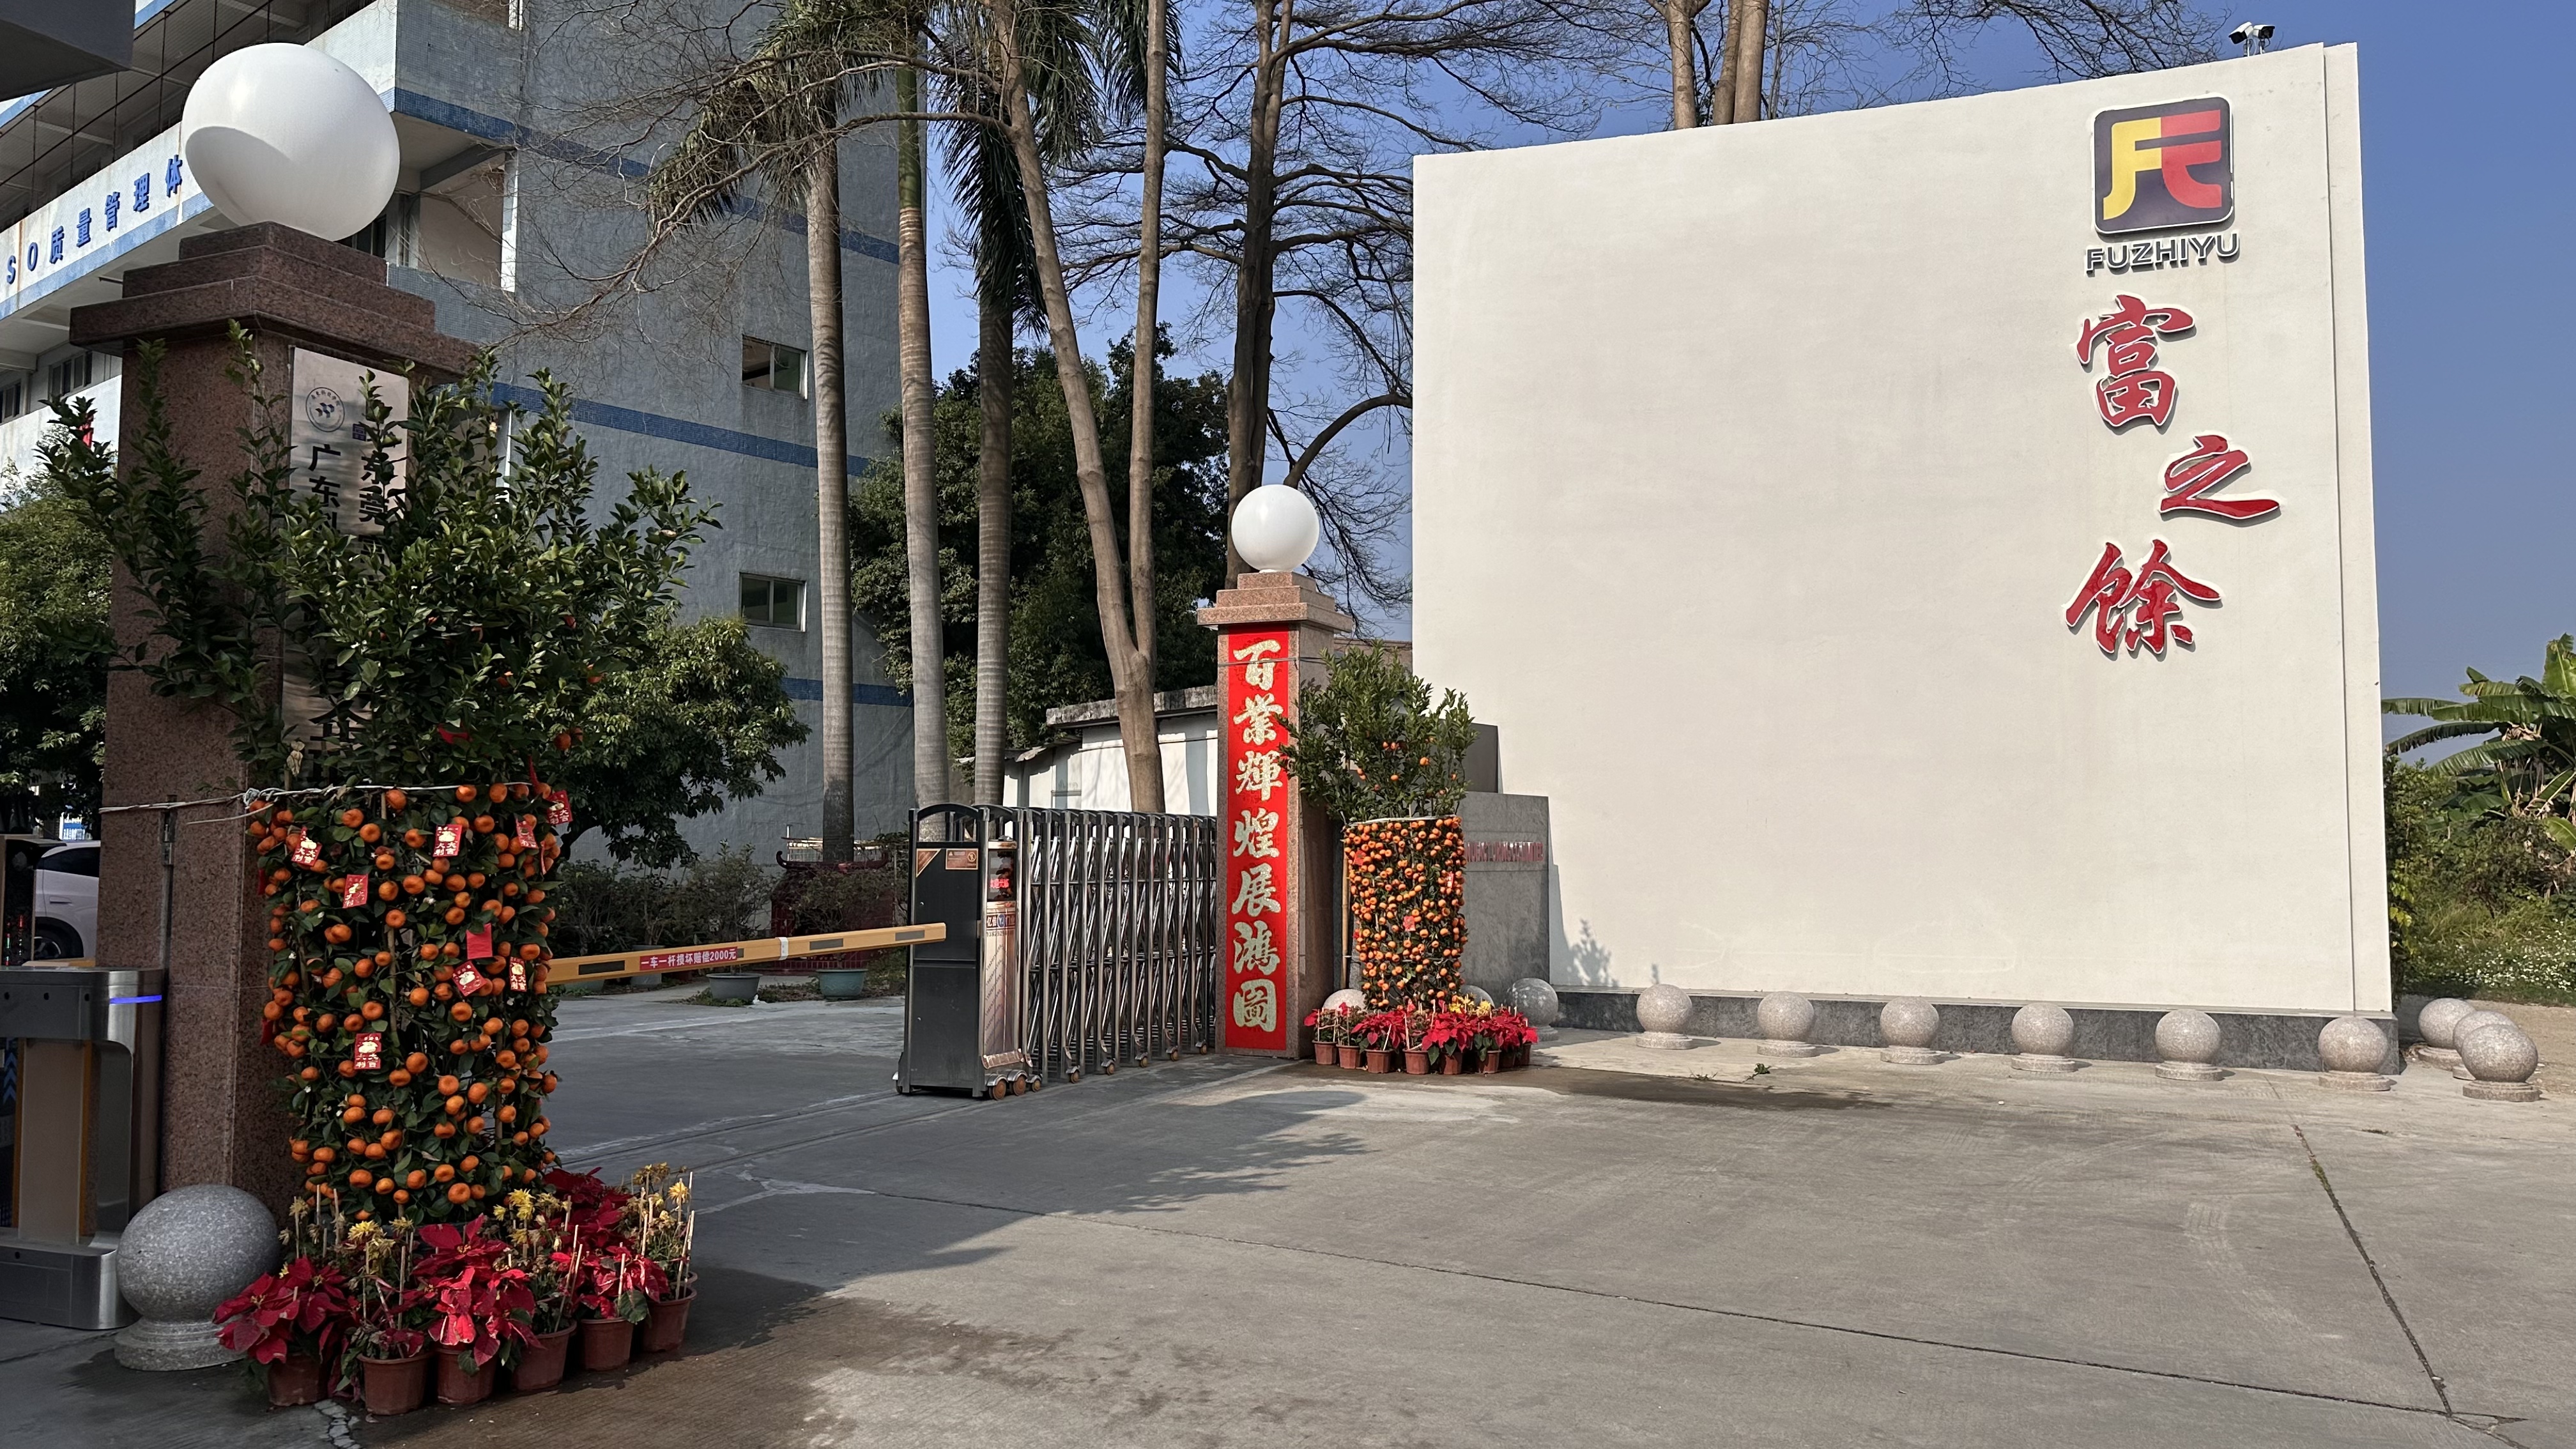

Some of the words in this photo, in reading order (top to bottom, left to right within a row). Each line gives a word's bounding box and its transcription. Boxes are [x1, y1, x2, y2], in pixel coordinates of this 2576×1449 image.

[2086, 233, 2240, 275] FUZHIYU
[1231, 639, 1284, 1033] 百業輝煌展鴻圖
[641, 949, 737, 969] 一车一杆损坏赔偿2000元
